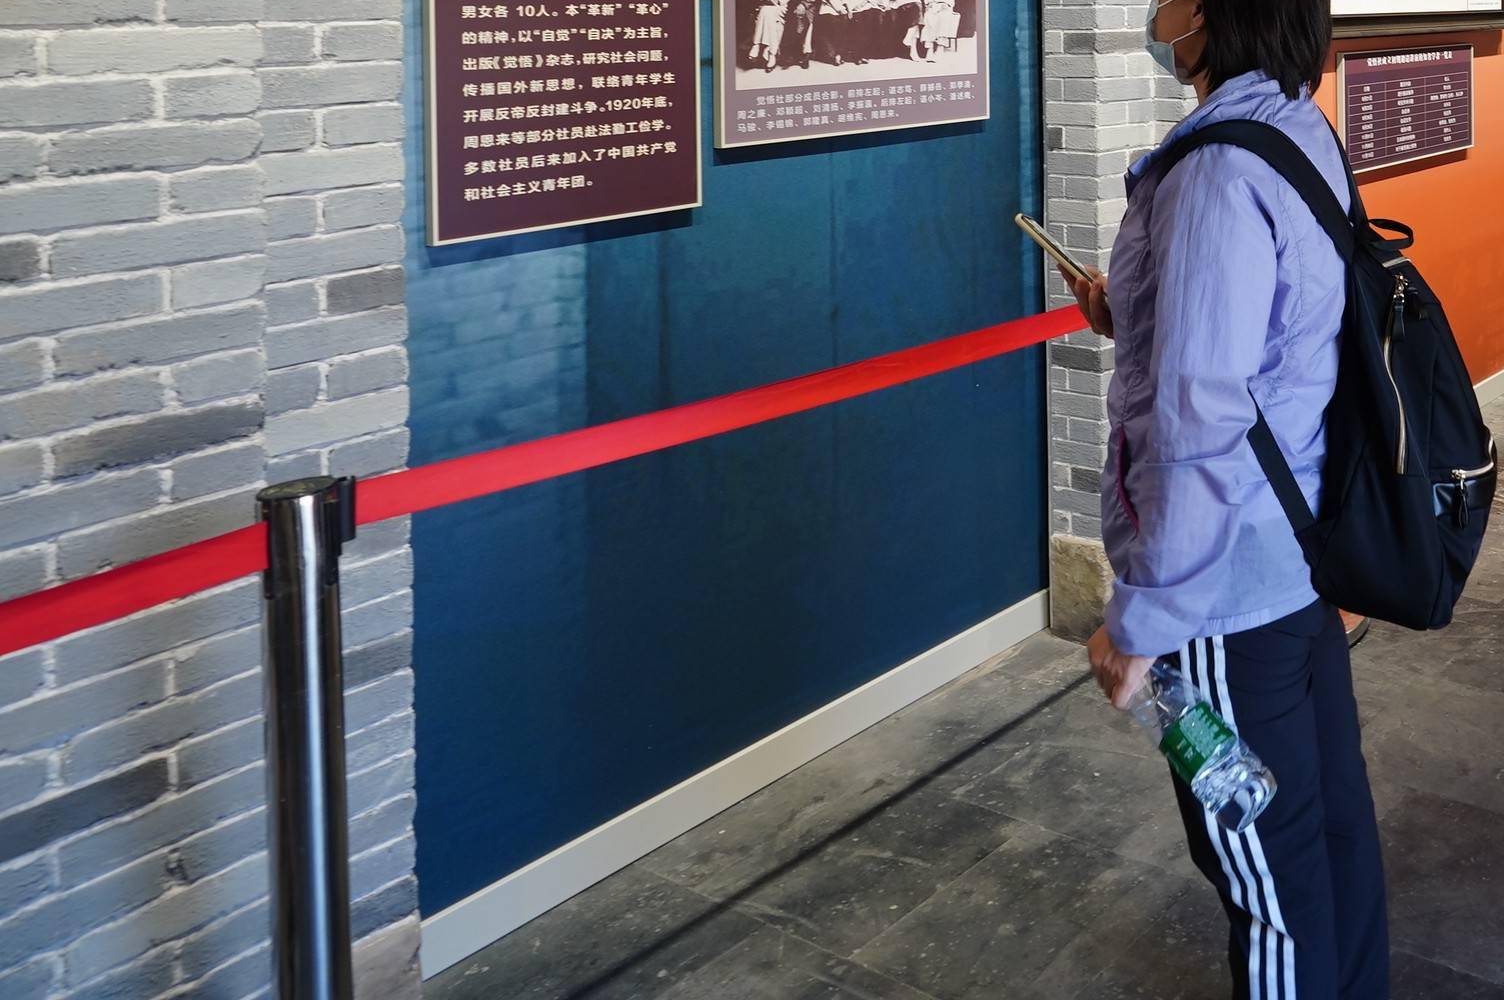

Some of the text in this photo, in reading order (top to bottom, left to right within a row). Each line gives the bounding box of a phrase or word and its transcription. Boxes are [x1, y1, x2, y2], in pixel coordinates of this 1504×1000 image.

[463, 141, 677, 176] 多数社员后来加入了中国共产党
[463, 175, 594, 201] 和社会主义青年团。
